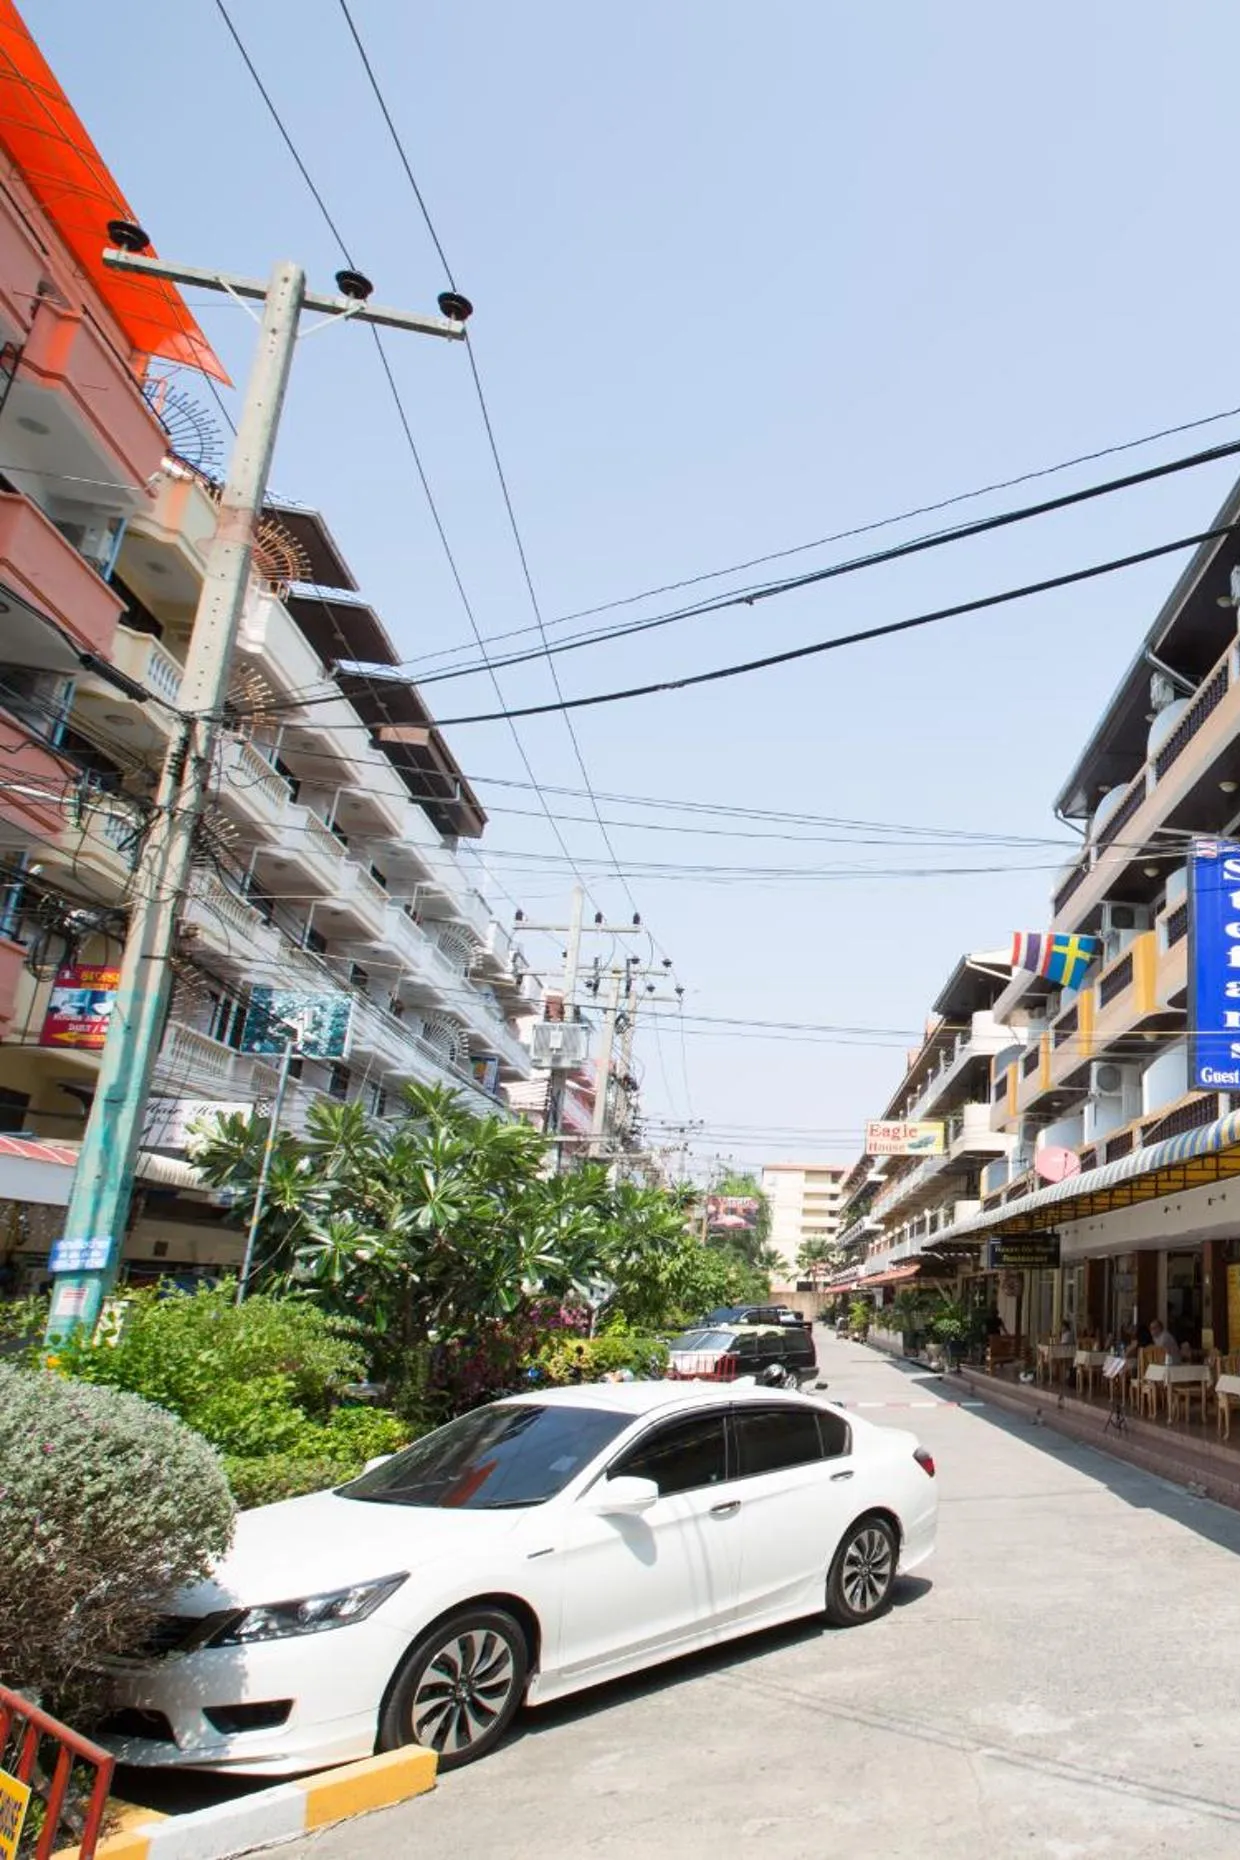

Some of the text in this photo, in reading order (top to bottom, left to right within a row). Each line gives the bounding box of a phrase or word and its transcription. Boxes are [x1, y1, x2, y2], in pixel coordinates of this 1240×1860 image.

[1201, 1066, 1240, 1085] Guest
[869, 1123, 918, 1141] Eagle
[869, 1142, 906, 1152] House
